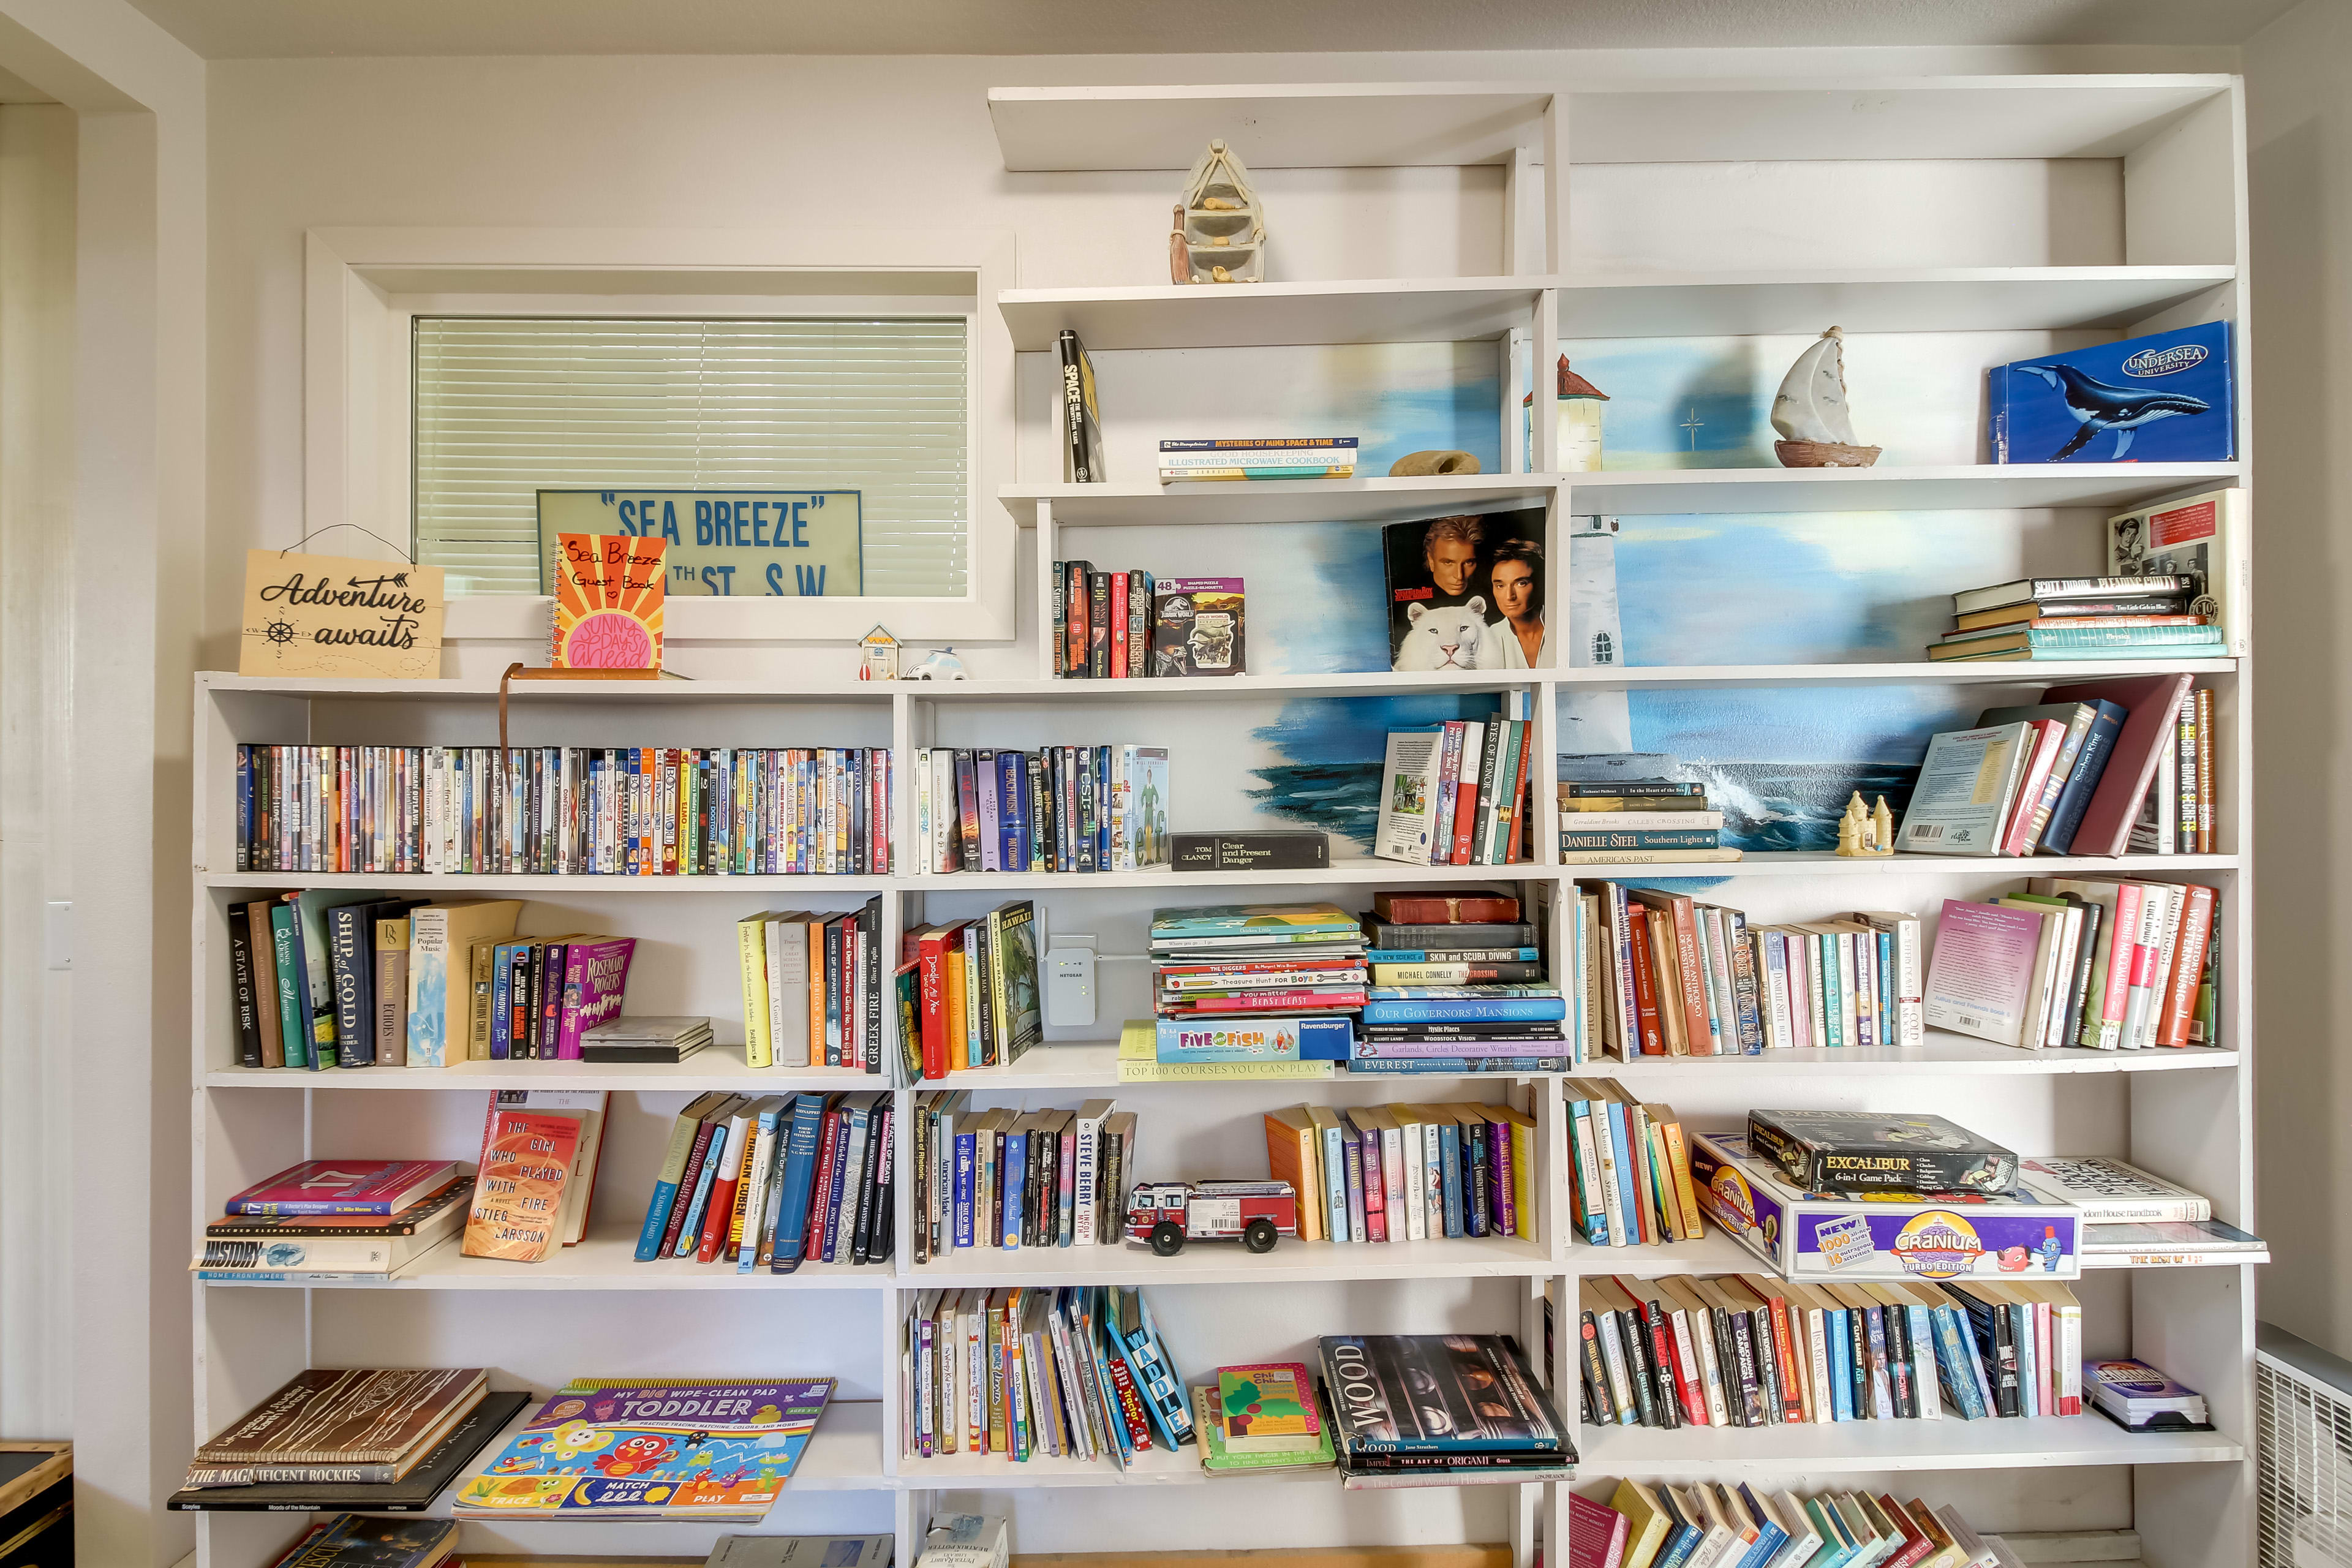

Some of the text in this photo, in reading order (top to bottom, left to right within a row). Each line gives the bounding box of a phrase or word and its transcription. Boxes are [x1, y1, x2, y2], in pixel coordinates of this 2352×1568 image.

[2128, 348, 2203, 370] UNDERSEA
[2138, 361, 2190, 375] UNIVERSITY
[1064, 364, 1080, 403] SPACE
[568, 541, 662, 565] Sea Breeze
[573, 572, 654, 590] Guest Book
[1158, 582, 1172, 590] 48
[262, 573, 425, 614] Adventure
[314, 615, 419, 649] awaits
[1131, 633, 1142, 668] MISERY
[1483, 722, 1499, 789] EYES OF HONOR
[2075, 733, 2101, 783] Stephen King
[1005, 769, 1017, 815] BEACH MUSIC
[1562, 834, 1638, 848] DANIELLE STEEL
[1681, 835, 1703, 845] Lights
[1241, 848, 1271, 857] Present
[1001, 911, 1031, 930] HAWAII
[2115, 908, 2136, 995] DEBBIE MACOMBER
[236, 948, 247, 984] STATE
[338, 912, 356, 1028] SHIP of GOLD
[587, 956, 627, 984] ROSEMARY
[1470, 970, 1497, 978] CROSSING
[1426, 970, 1452, 979] CONNELLY
[1686, 934, 1703, 1018] NORTON ANTHOLOGY
[594, 974, 620, 993] ROGERS
[239, 987, 248, 1003] OF
[497, 985, 507, 1020] EVANOVICH
[241, 1005, 251, 1030] RISK
[383, 1003, 395, 1036] ECHOES
[1376, 1009, 1400, 1018] OUR
[1476, 1008, 1534, 1017] MANSIONS
[869, 992, 880, 1065] GREEK FIRE
[1125, 1067, 1148, 1076] TOP
[1173, 1066, 1227, 1074] COURSES
[1231, 1065, 1255, 1074] YOU
[1261, 1065, 1284, 1073] CAN
[1290, 1064, 1319, 1072] PLAY
[508, 1122, 528, 1133] THE
[530, 1139, 557, 1152] GIRL
[489, 1150, 515, 1163] WHO
[1826, 1156, 1910, 1171] EXCALIBUR
[519, 1165, 563, 1180] PLAYED
[1079, 1134, 1092, 1206] STEVE BERRY
[486, 1180, 516, 1193] WITH
[1836, 1174, 1902, 1183] 6-in-1 Game Pack
[521, 1197, 548, 1212] FIRE
[474, 1208, 508, 1221] STIEG
[1820, 1219, 1861, 1237] NEW!
[1851, 1226, 1872, 1237] all-new
[1820, 1234, 1850, 1252] 1000
[1841, 1241, 1874, 1256] outrageous
[200, 1241, 263, 1268] HISTORY
[1828, 1253, 1841, 1265] 16
[1842, 1249, 1871, 1262] activities
[1903, 1263, 1972, 1273] TURBO EDITION
[1606, 1328, 1623, 1383] SUSAN WIGGS
[639, 1389, 666, 1398] BIG
[670, 1389, 749, 1398] WIPE-CLEAN
[752, 1388, 776, 1396] PAD
[1334, 1345, 1384, 1428] WOOD
[622, 1400, 751, 1417] TODDLER
[1125, 1388, 1138, 1421] Tractor
[1356, 1442, 1396, 1452] WOOD
[1447, 1456, 1488, 1465] ORIGAMI
[191, 1469, 361, 1482] THE MAGNIFICENT ROCKIES
[694, 1494, 725, 1503] PLAY
